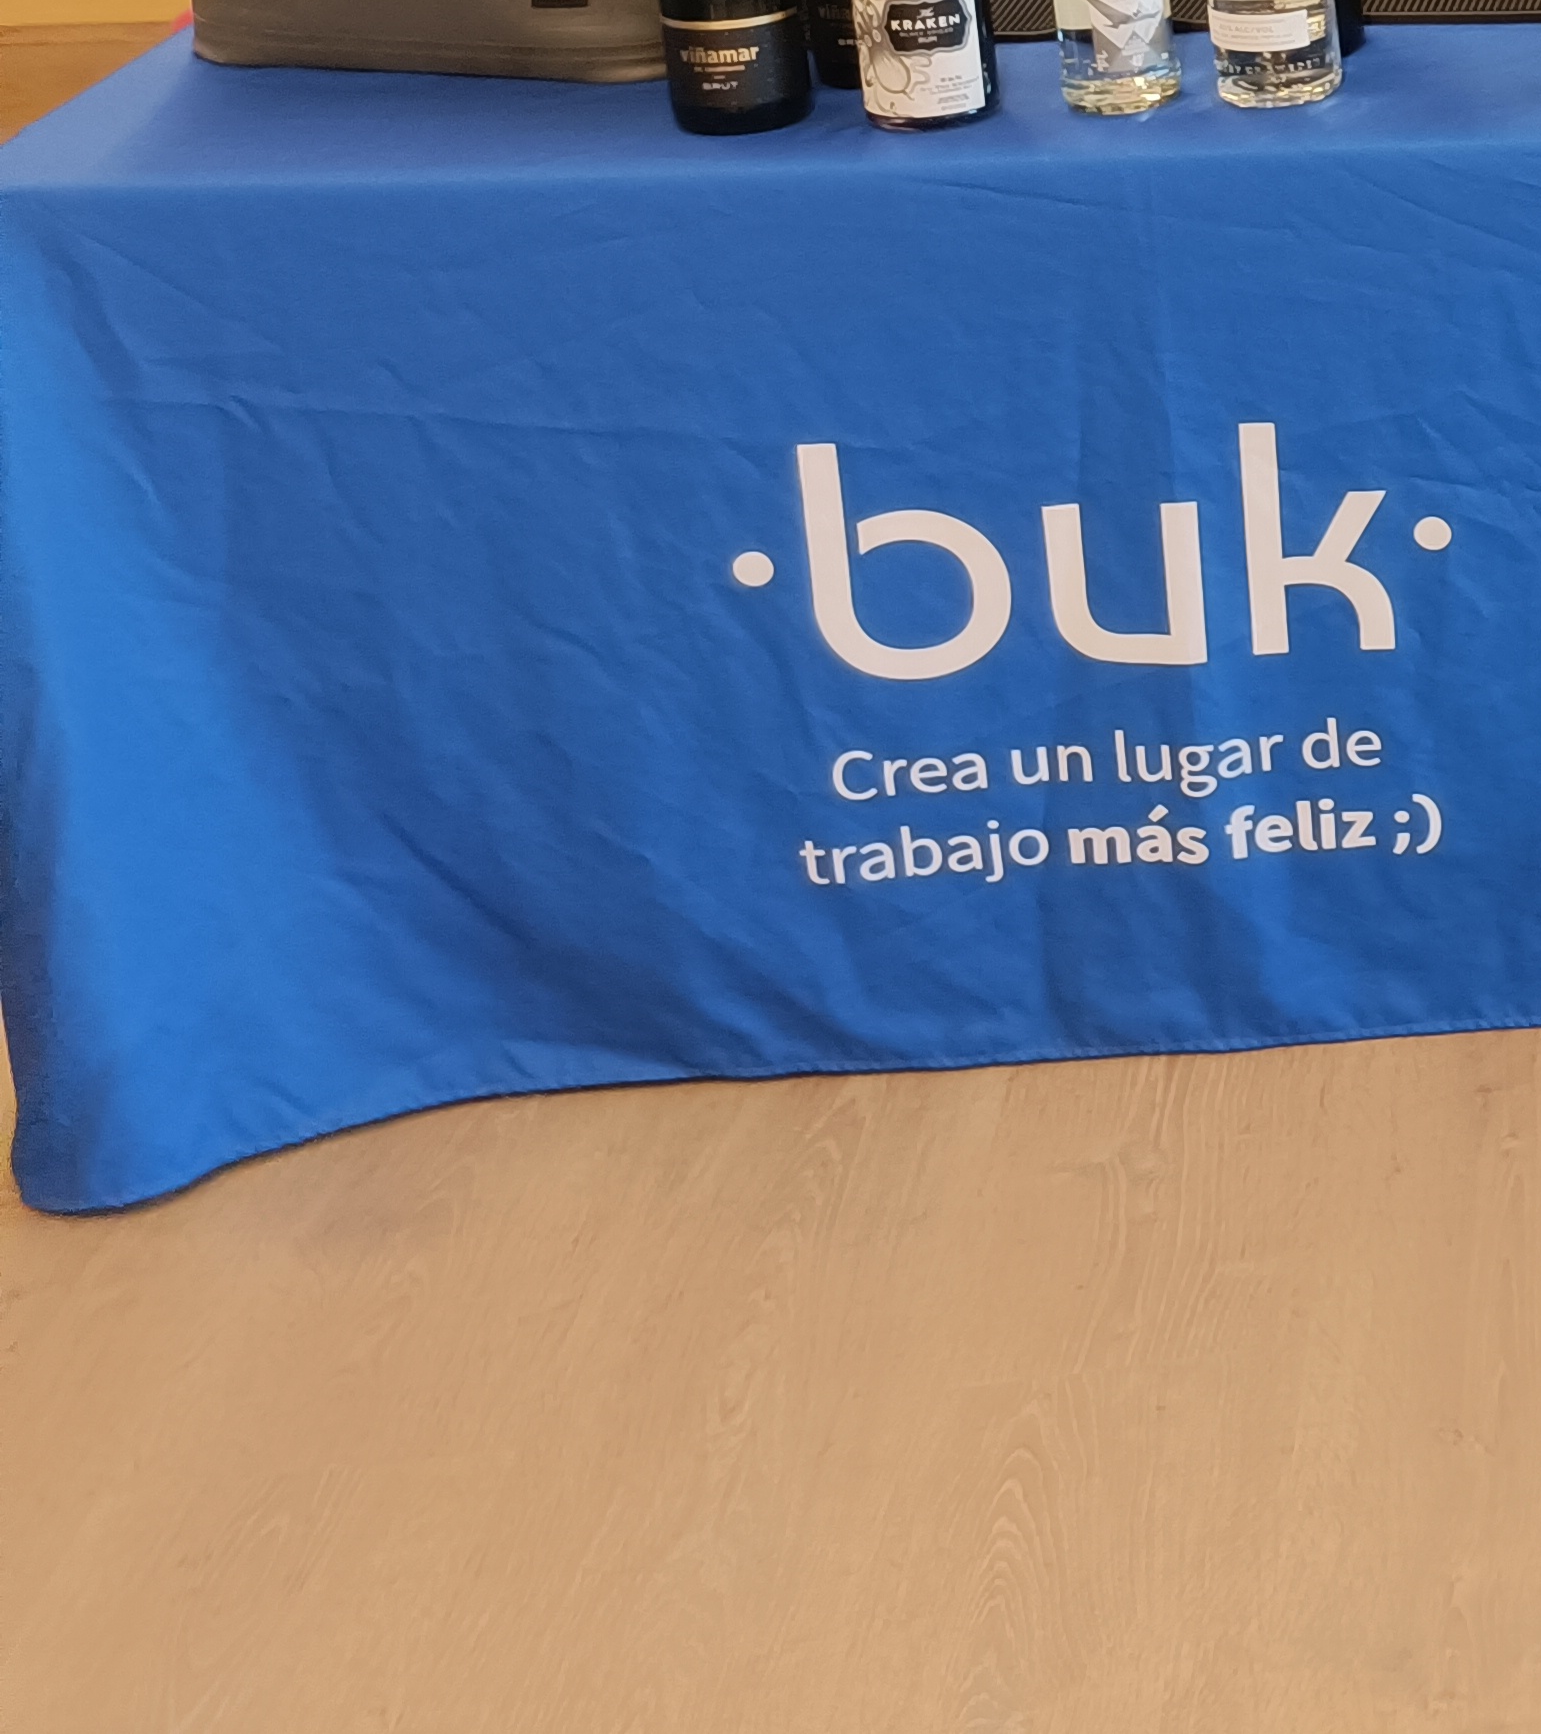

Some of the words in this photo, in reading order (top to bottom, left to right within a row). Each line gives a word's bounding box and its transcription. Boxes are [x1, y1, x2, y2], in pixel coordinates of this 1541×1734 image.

[890, 13, 961, 31] KRAKEN
[680, 45, 760, 65] viñamar
[702, 80, 739, 91] BRUT
[797, 422, 1397, 680] buk
[831, 750, 989, 801] Crea
[1011, 740, 1094, 786] un
[1115, 728, 1284, 797] lugar
[1301, 717, 1382, 769] de
[800, 819, 1050, 885] trabajo
[1067, 804, 1210, 866] más
[1226, 797, 1378, 860] feliz
